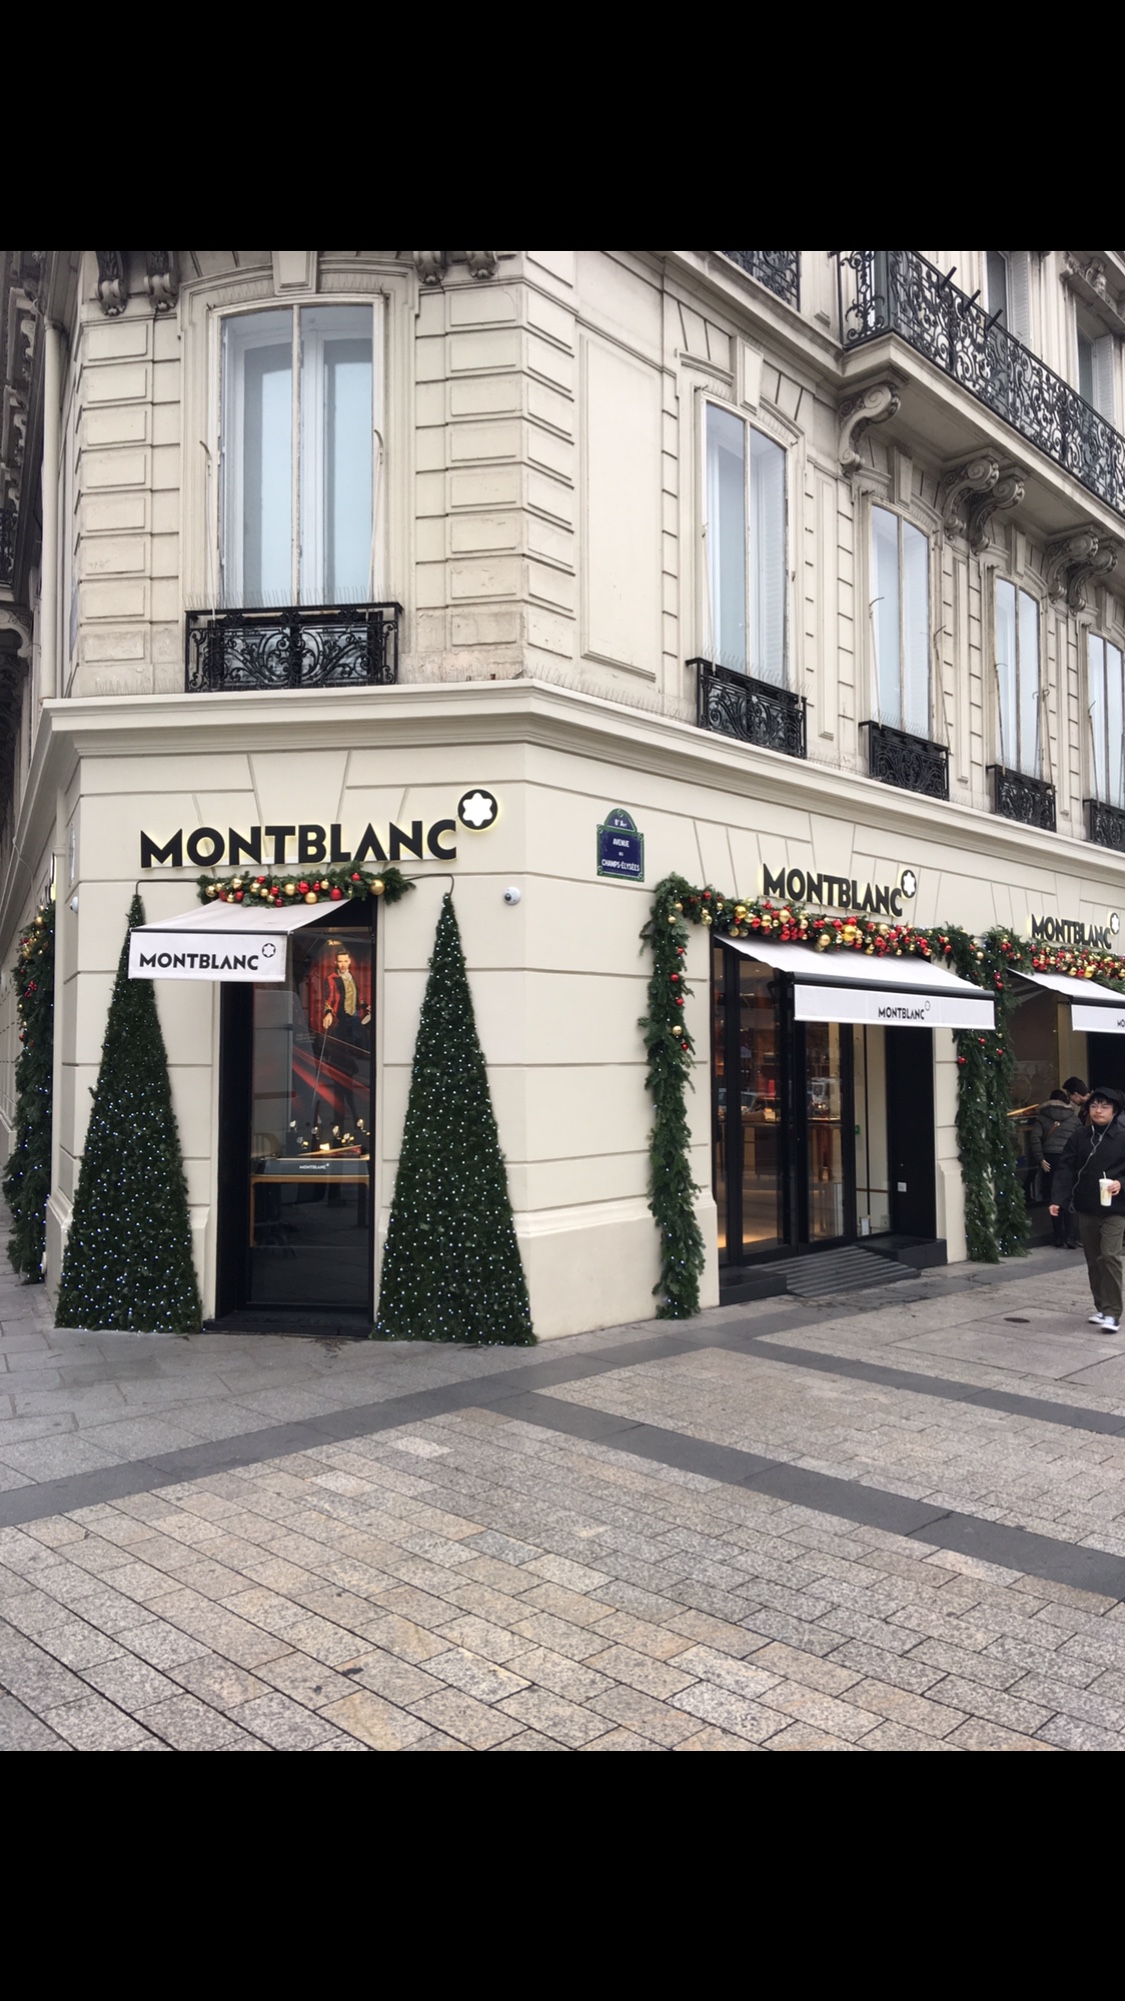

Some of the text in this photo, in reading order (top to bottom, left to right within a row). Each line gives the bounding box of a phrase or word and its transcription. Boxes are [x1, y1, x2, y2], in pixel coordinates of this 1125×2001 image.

[140, 819, 457, 868] MONTBLANC
[612, 838, 630, 848] AVENUE
[763, 863, 902, 916] MONTBLANC
[1031, 913, 1112, 949] MONTBLANC
[139, 952, 259, 970] MONTBLANC
[878, 1006, 925, 1020] MONTBLANC
